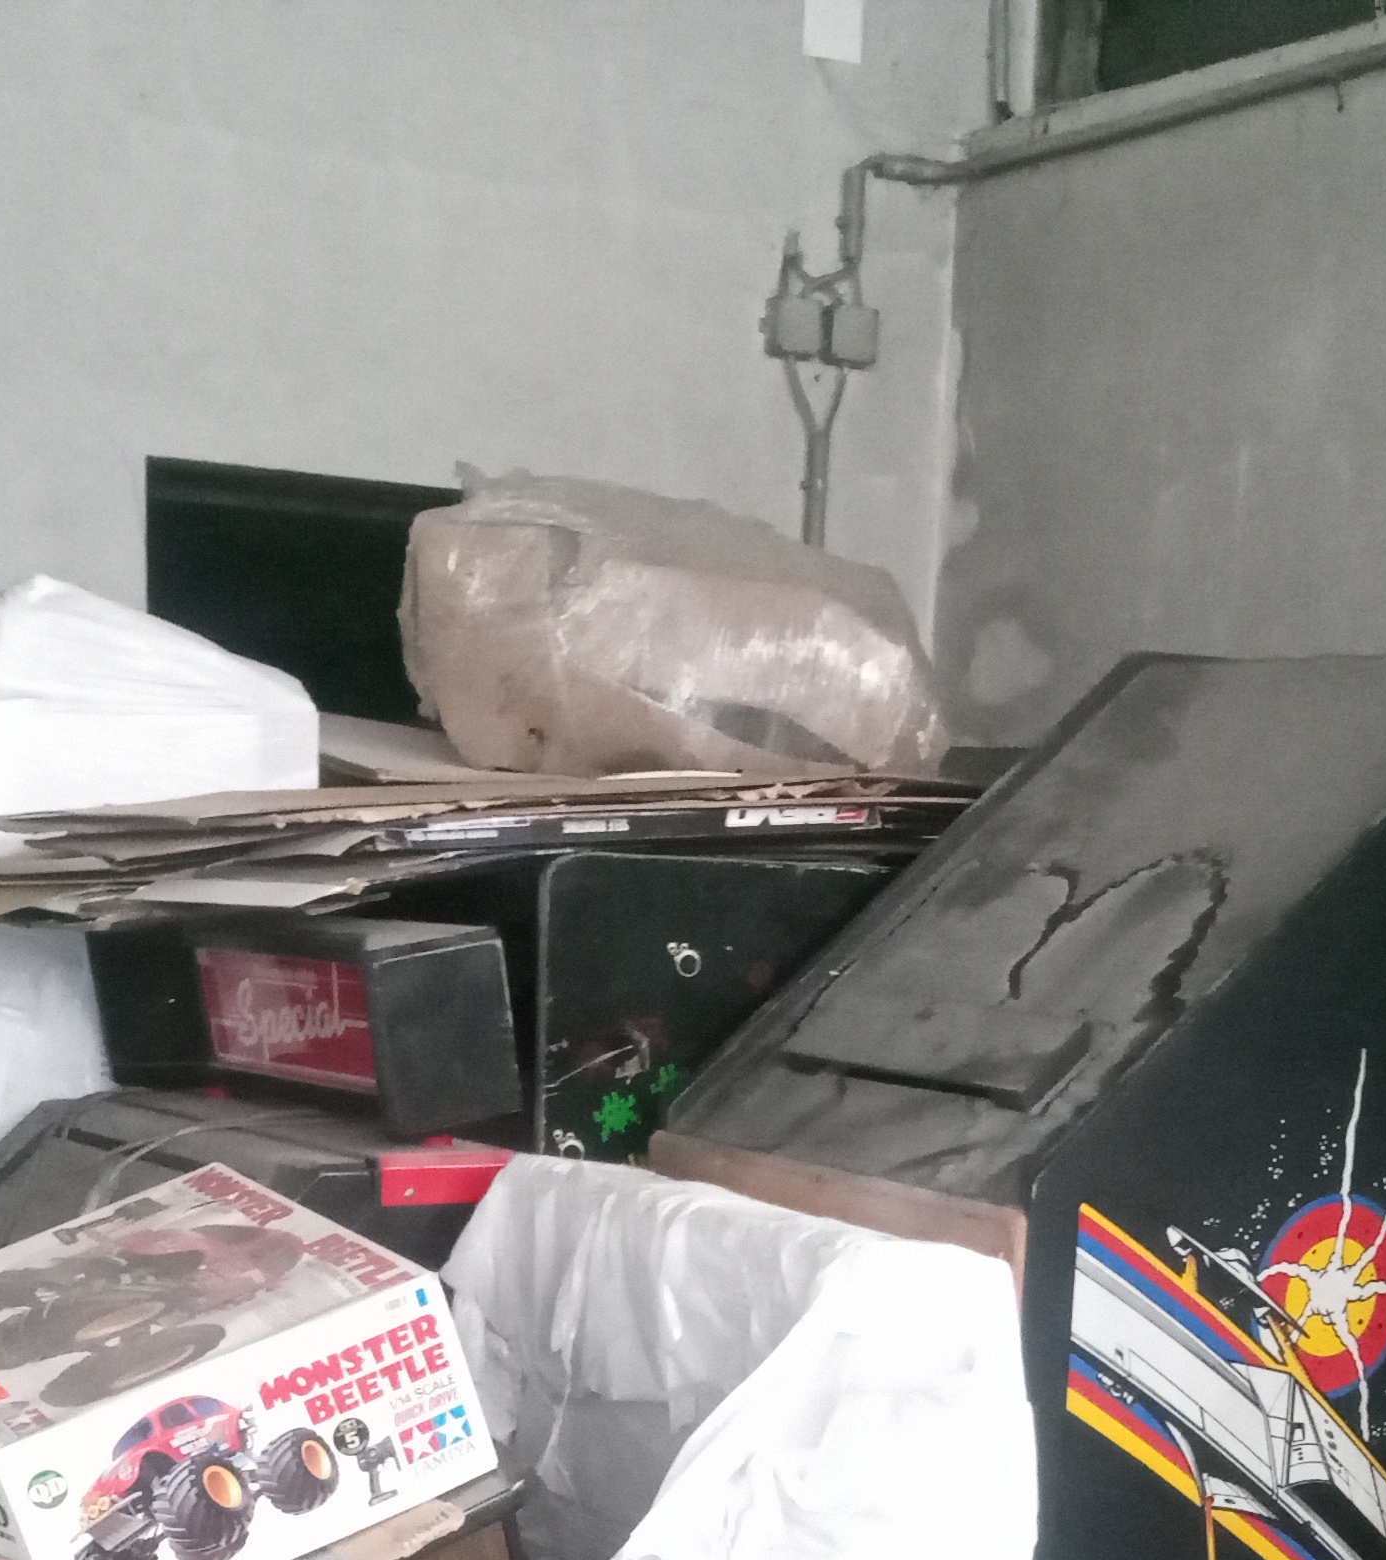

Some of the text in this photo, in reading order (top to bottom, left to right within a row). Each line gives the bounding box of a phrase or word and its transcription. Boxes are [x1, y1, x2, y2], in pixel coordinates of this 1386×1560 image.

[259, 1313, 441, 1410] MONSTER
[304, 1342, 450, 1426] BEETLE
[414, 1373, 456, 1398] SCALE
